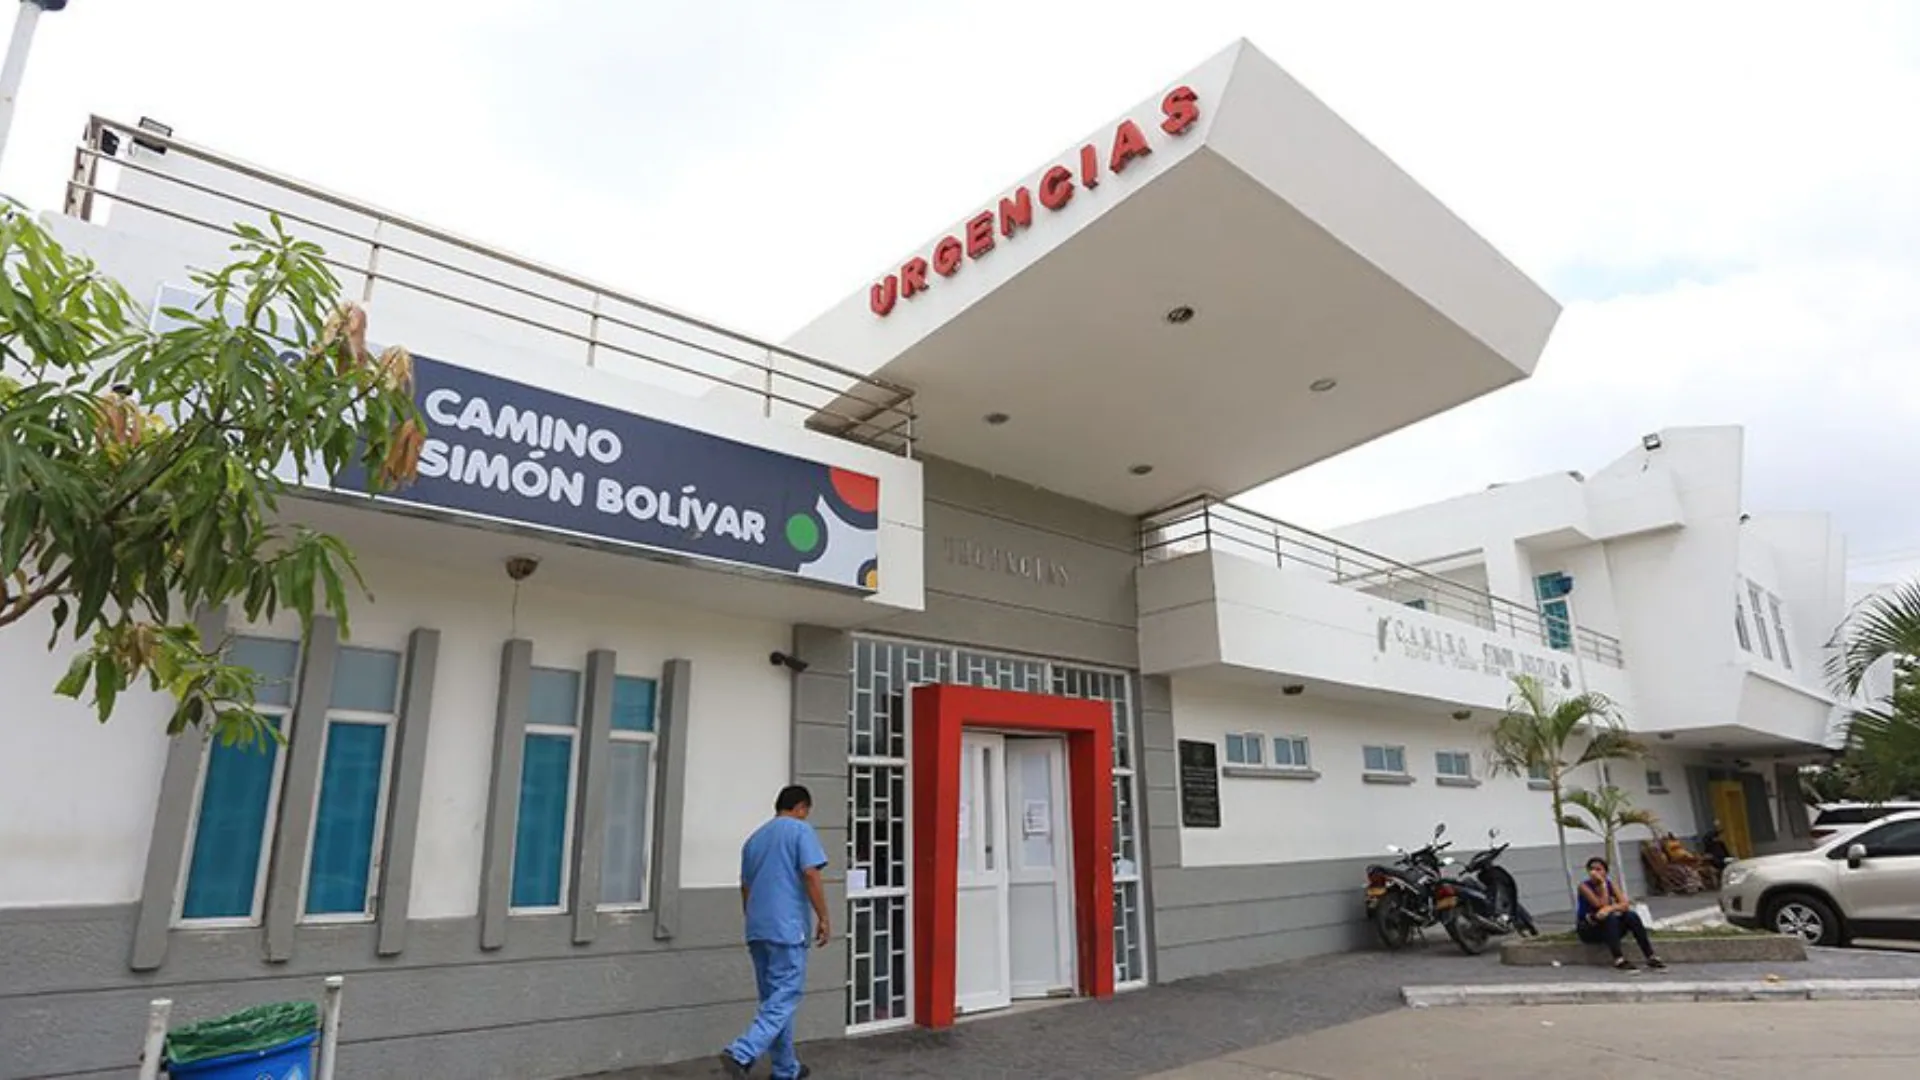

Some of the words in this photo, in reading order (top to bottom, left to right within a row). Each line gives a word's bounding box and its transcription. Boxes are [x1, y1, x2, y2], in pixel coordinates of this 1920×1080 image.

[870, 85, 1199, 316] URGENCIAS
[425, 388, 622, 463] CAMINO
[416, 438, 584, 506] SIMÓN
[596, 477, 766, 544] BOLÍVAR
